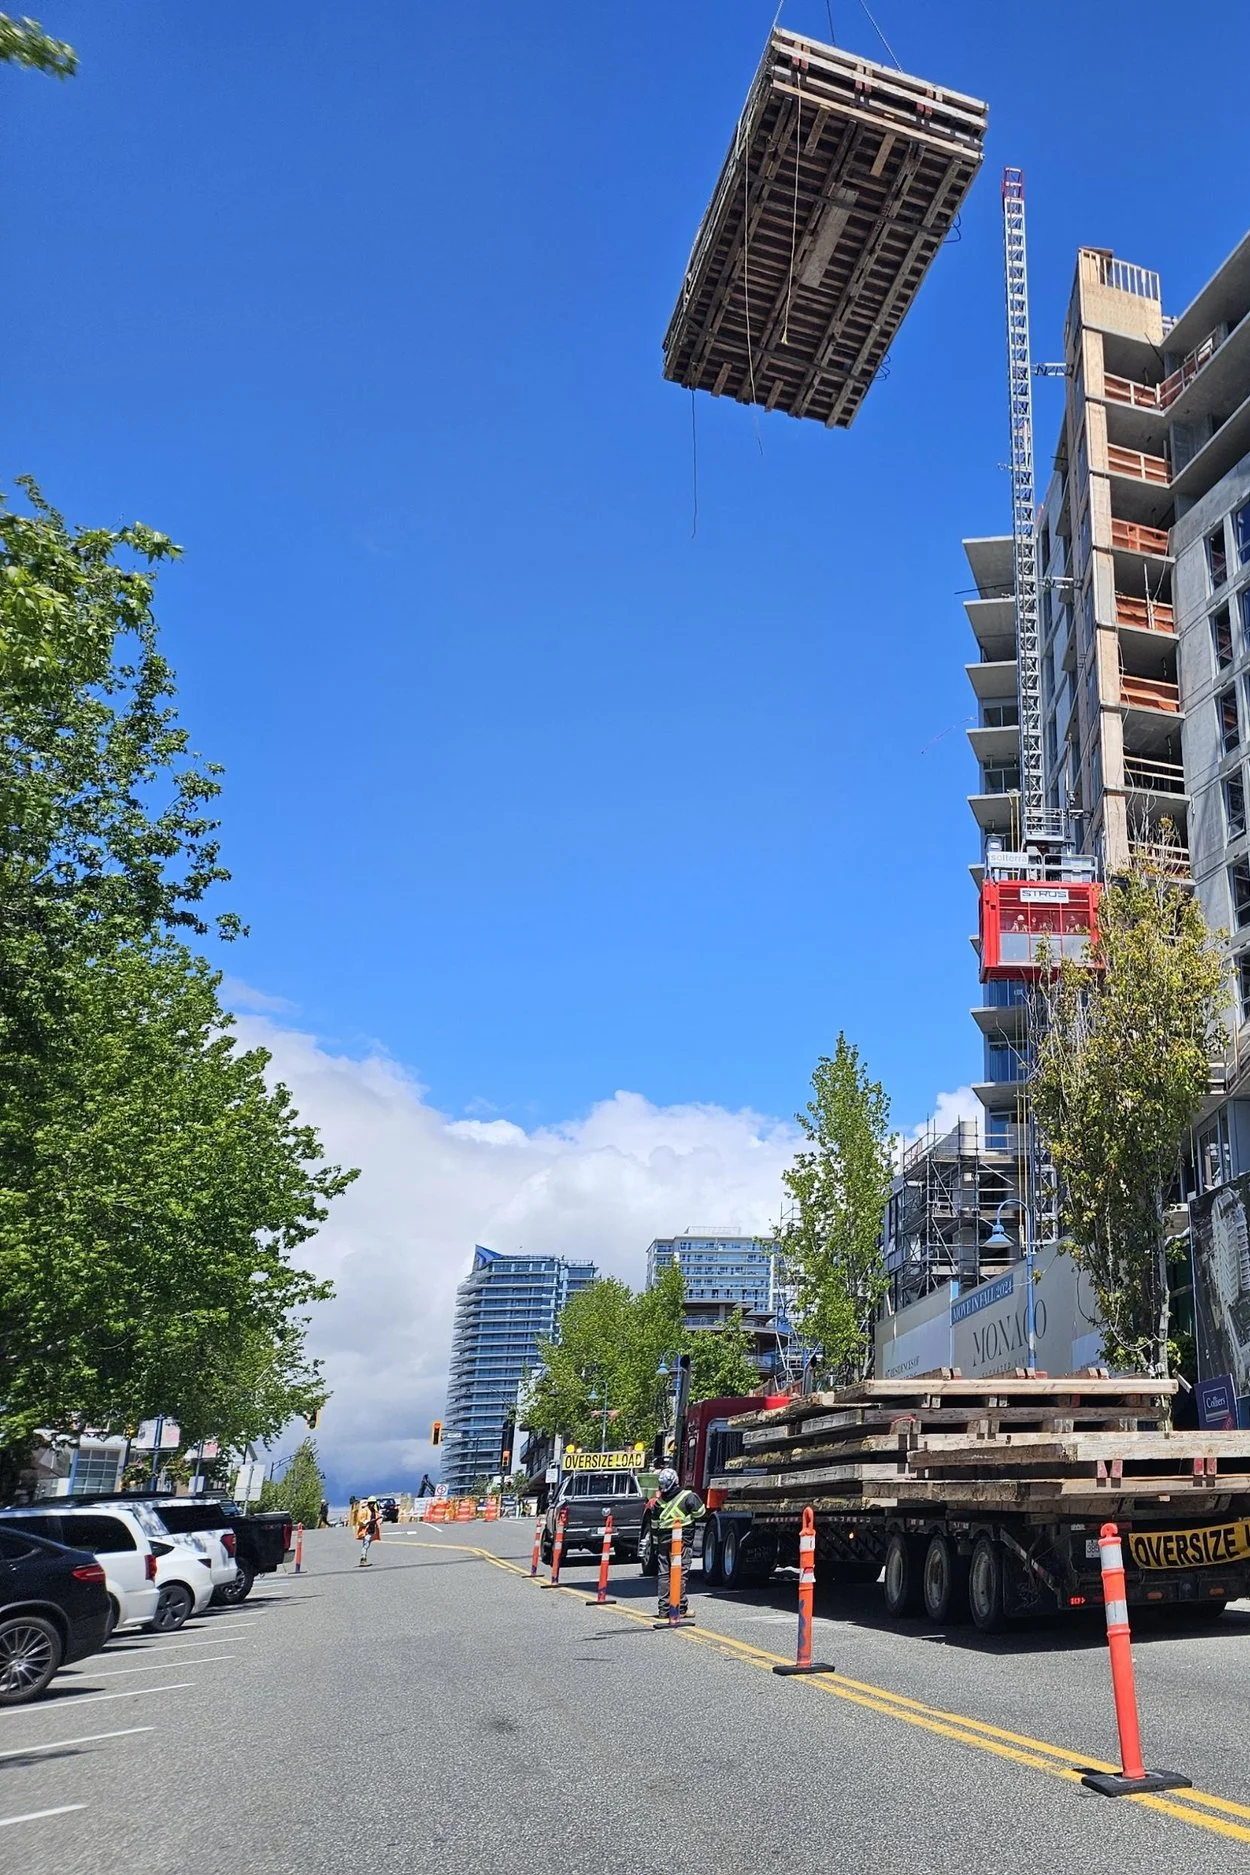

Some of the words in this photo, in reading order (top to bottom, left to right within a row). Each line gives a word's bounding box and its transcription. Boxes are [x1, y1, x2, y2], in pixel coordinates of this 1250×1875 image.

[952, 1299, 971, 1320] MOVE
[970, 1295, 980, 1313] IN
[980, 1286, 996, 1308] FALL
[996, 1280, 1013, 1299] 2024
[1206, 1396, 1226, 1409] Colliers
[565, 1454, 613, 1469] OVERSIZE
[615, 1453, 642, 1467] LOAD
[1134, 1527, 1241, 1567] OVERSIZE
